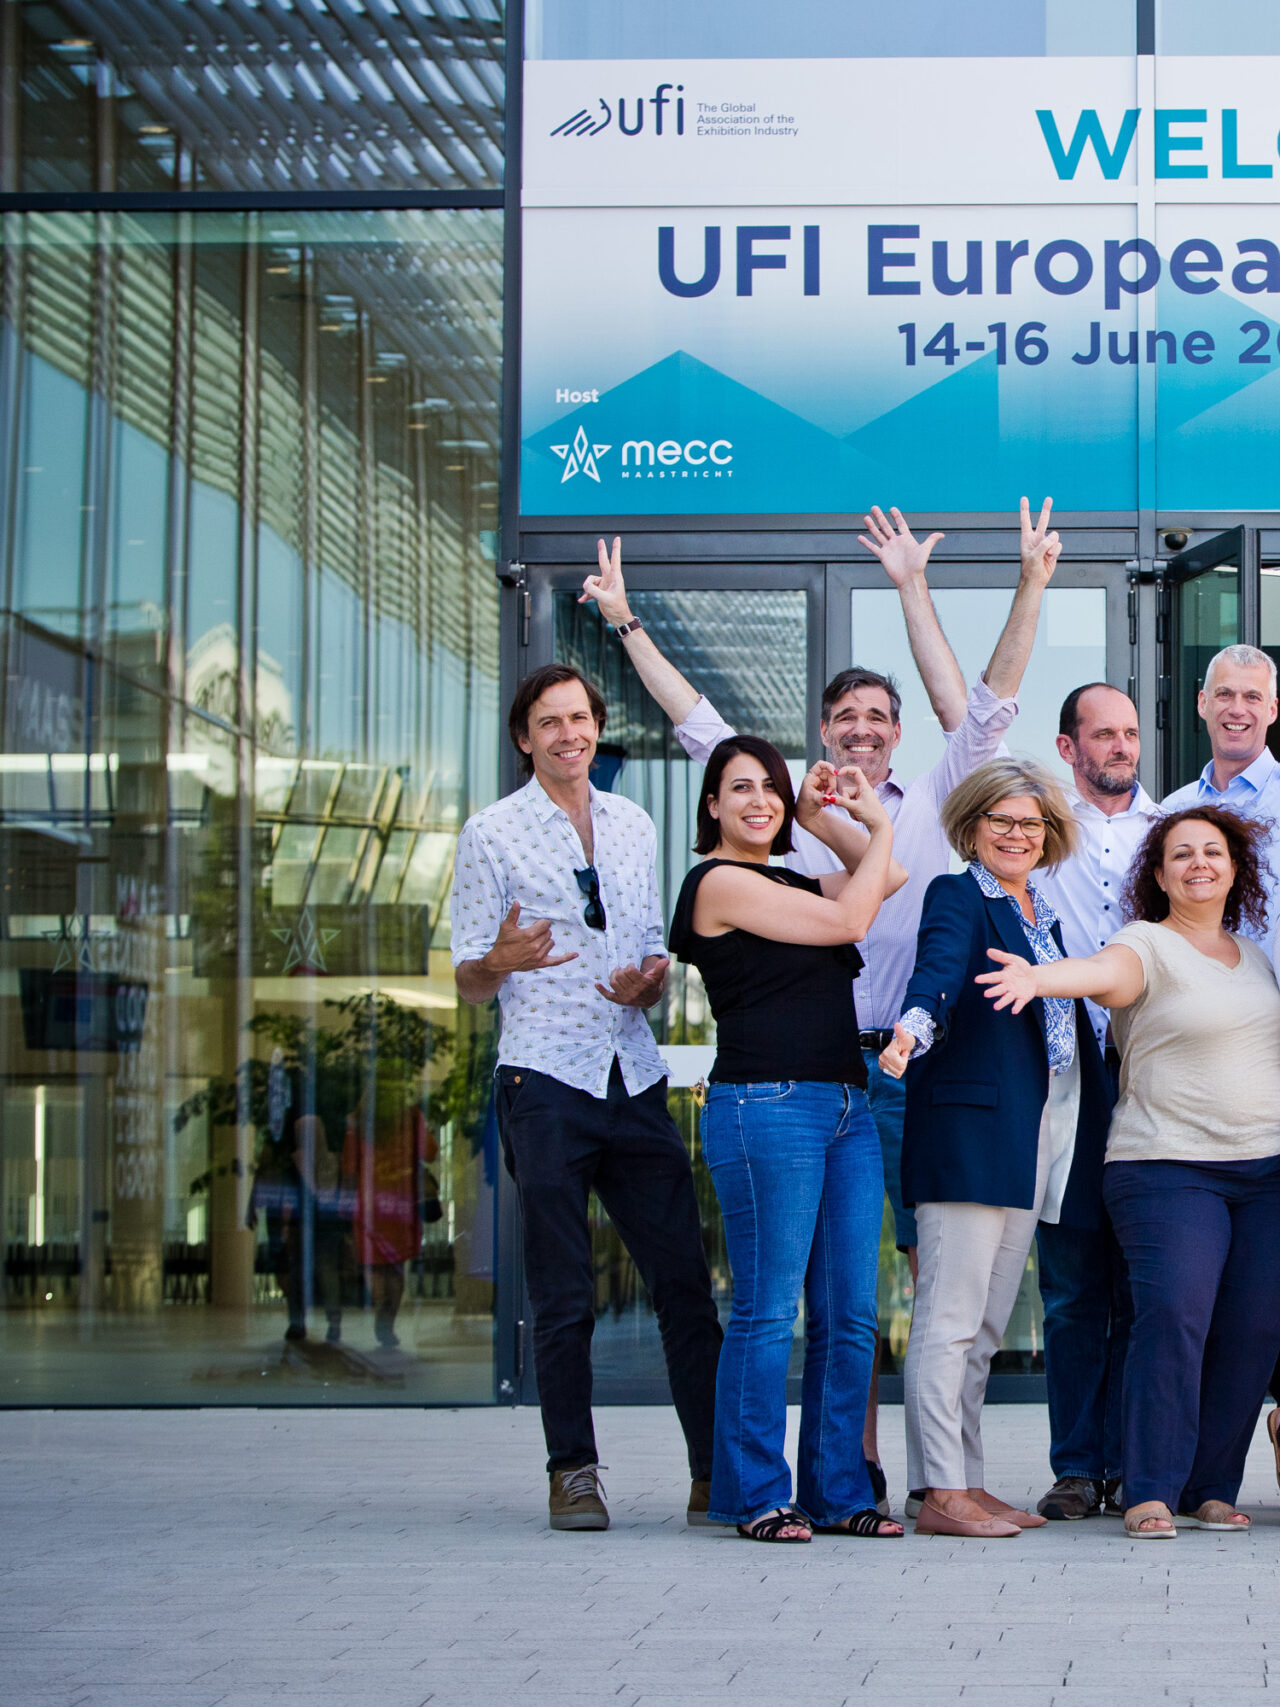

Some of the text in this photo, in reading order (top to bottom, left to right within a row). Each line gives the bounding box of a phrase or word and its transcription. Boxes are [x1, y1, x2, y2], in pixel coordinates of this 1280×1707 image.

[618, 83, 684, 136] ufi
[697, 103, 756, 113] The Global
[697, 114, 795, 125] Association of the
[697, 126, 799, 137] Exhibition Industry
[658, 224, 820, 297] UFI
[898, 322, 1049, 366] 14-16
[1071, 321, 1216, 366] June
[556, 388, 600, 403] Host
[621, 439, 733, 466] mecc
[621, 470, 734, 479] MAASTRICHT
